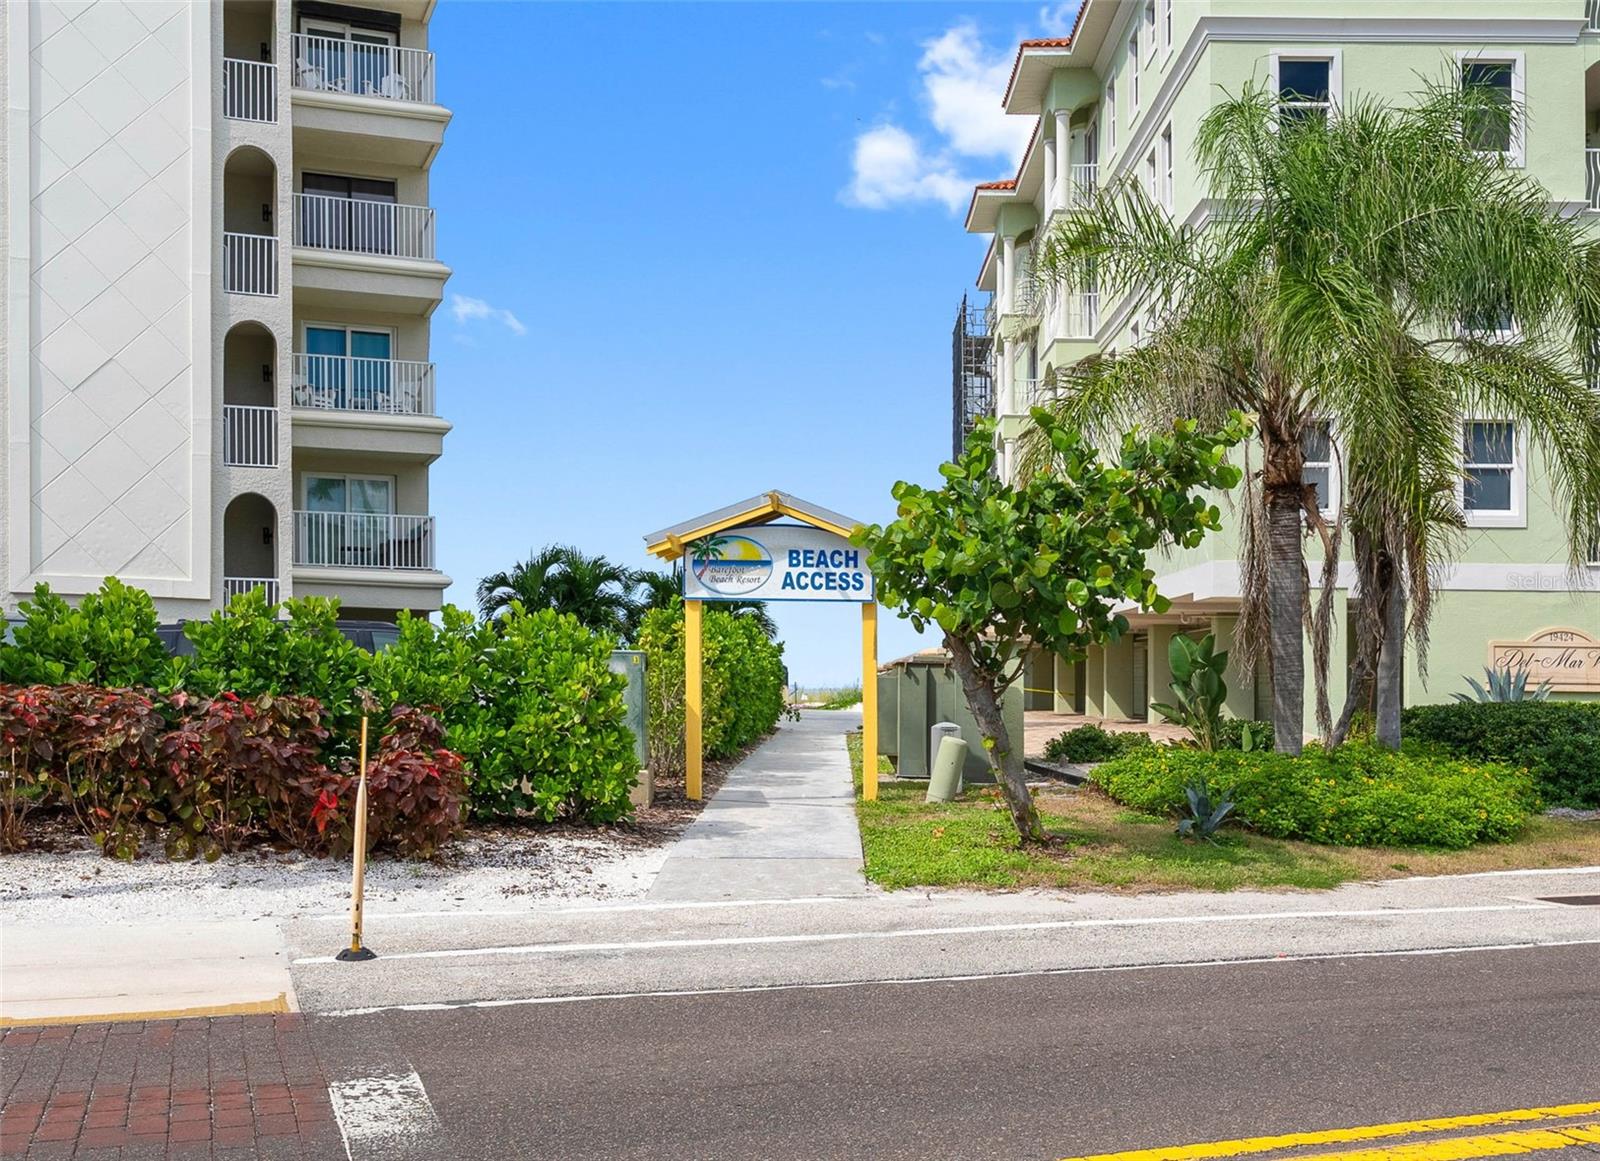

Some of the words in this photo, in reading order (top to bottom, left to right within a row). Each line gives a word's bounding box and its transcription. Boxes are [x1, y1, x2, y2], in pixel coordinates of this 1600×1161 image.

[788, 549, 858, 568] BEACH
[710, 566, 745, 576] Barefoot
[710, 575, 734, 583] Beach
[736, 575, 761, 584] Resort
[781, 571, 864, 591] ACCESS
[1550, 632, 1574, 642] 19424
[1495, 648, 1584, 669] Del-Mar
